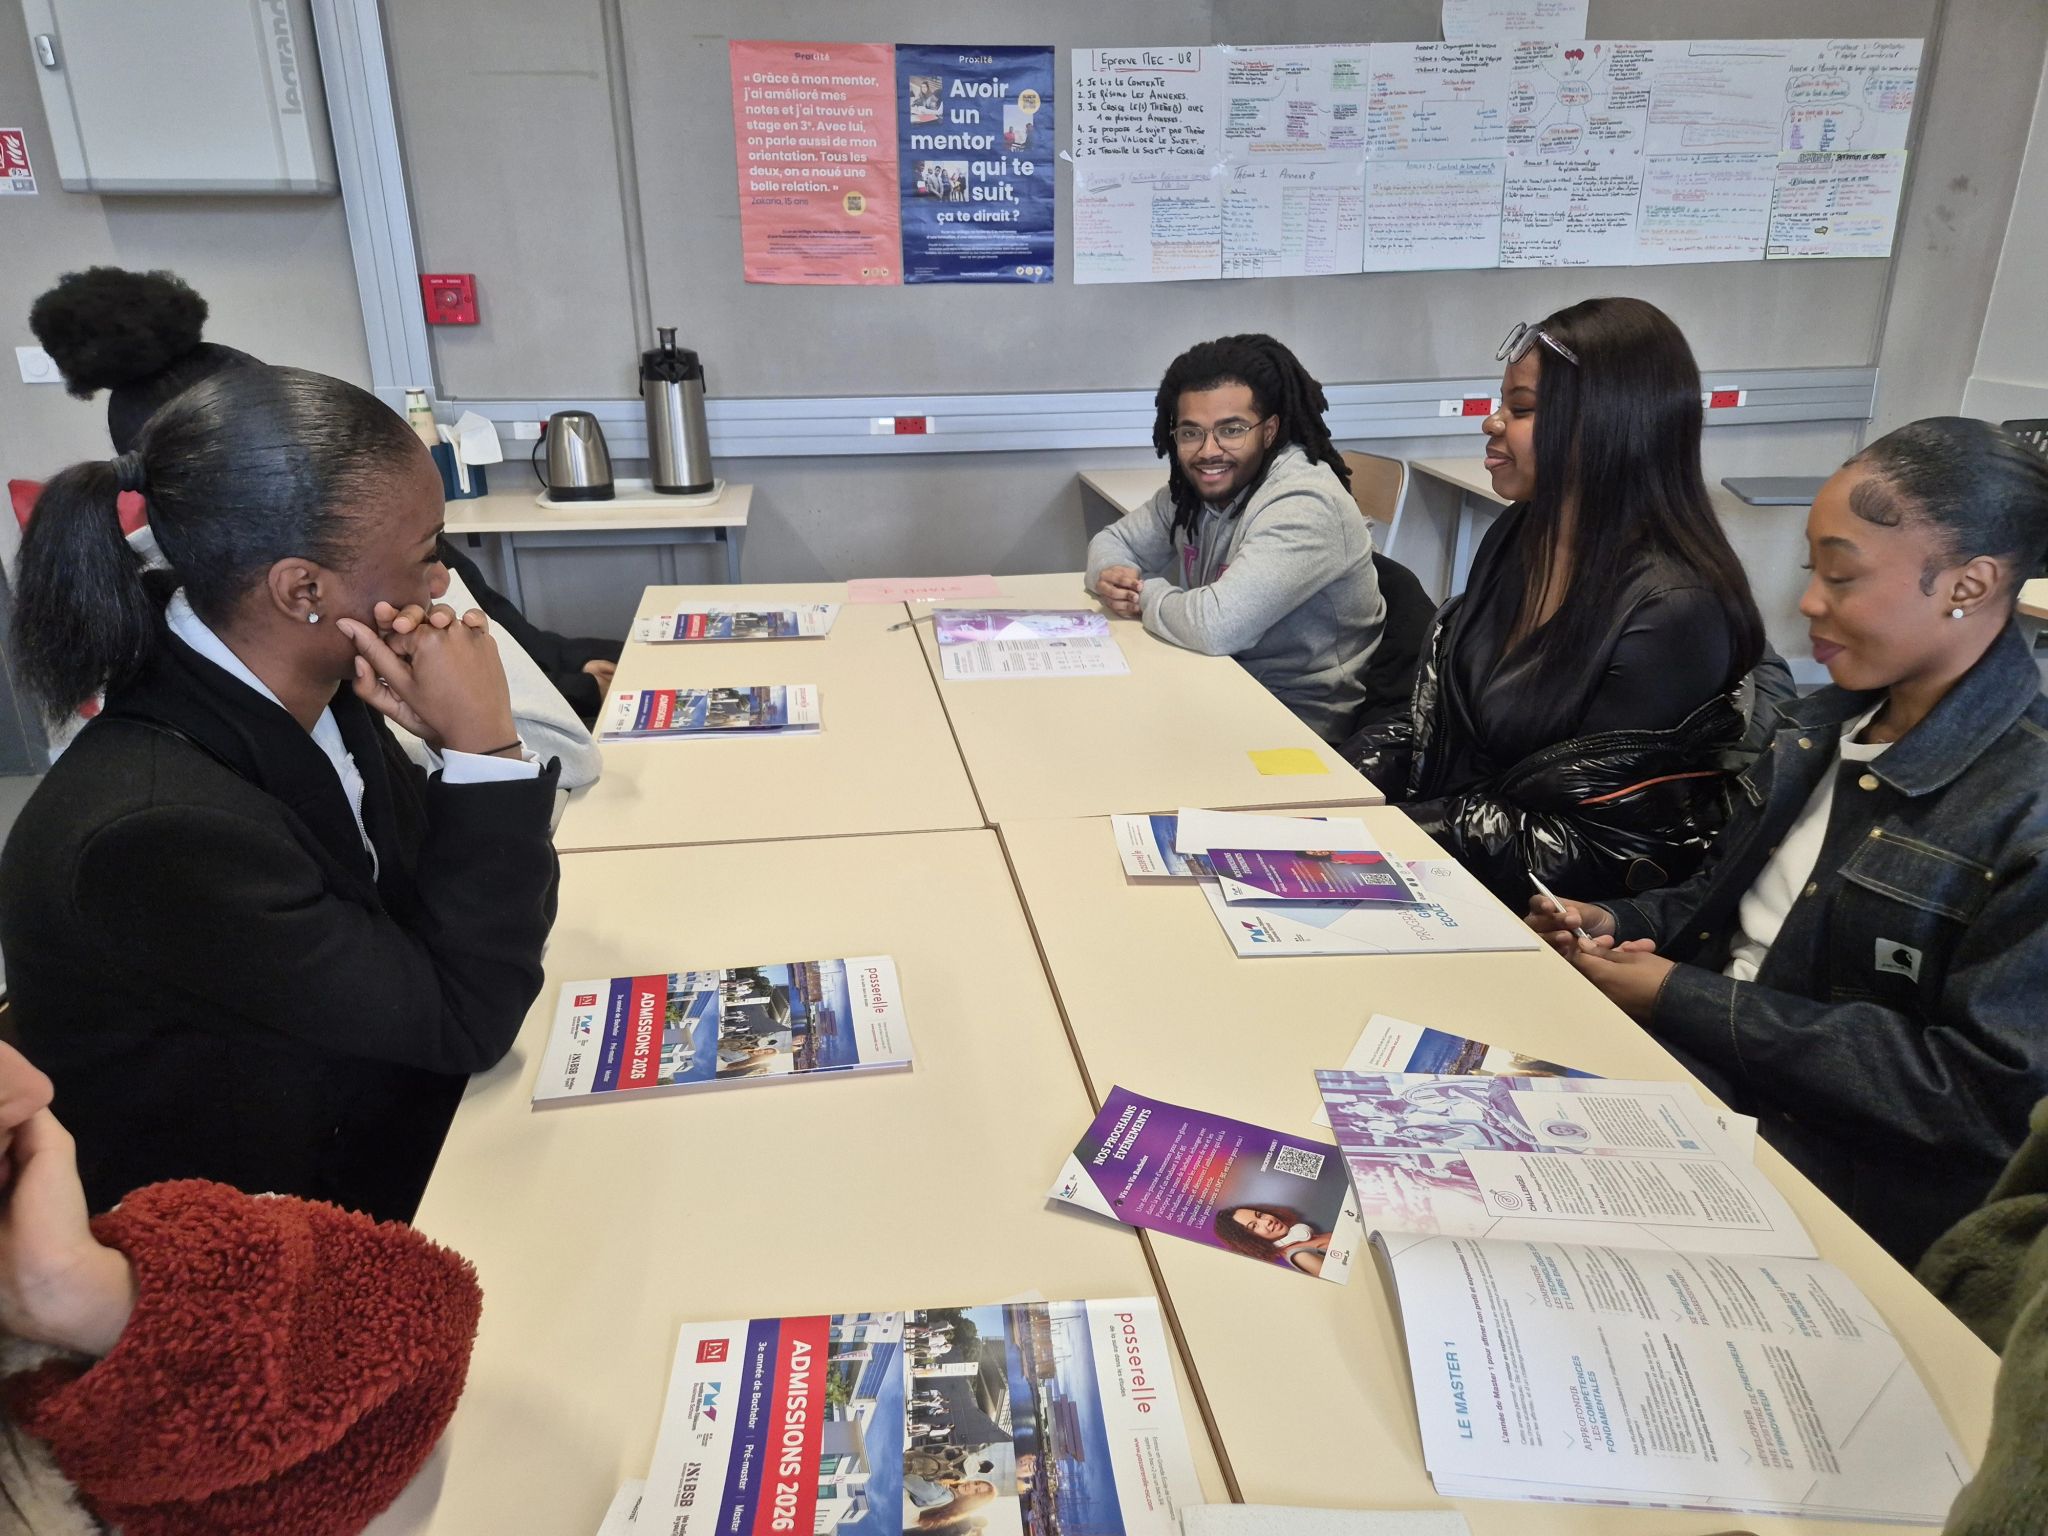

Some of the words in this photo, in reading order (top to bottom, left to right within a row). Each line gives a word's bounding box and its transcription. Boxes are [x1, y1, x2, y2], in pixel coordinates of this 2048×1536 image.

[794, 52, 831, 61] Proxité
[959, 55, 993, 64] Proxité
[752, 72, 789, 84] Grâce
[791, 73, 799, 84] à
[802, 76, 829, 84] mon
[831, 76, 879, 87] mentor,
[950, 77, 1009, 98] Avoir
[744, 87, 763, 101] j'ai
[765, 88, 819, 100] amélioré
[821, 91, 847, 100] mes
[745, 105, 780, 115] notes
[781, 105, 794, 115] et
[796, 104, 814, 118] j'ai
[815, 105, 855, 117] trouvé
[857, 107, 873, 117] un
[950, 108, 980, 124] un
[746, 120, 780, 132] stage
[783, 122, 798, 131] en
[817, 121, 846, 132] Avec
[848, 121, 866, 133] lui,
[748, 136, 763, 146] on
[765, 135, 797, 149] parle
[798, 136, 831, 146] aussi
[832, 136, 847, 147] de
[849, 138, 877, 147] mon
[911, 132, 995, 150] mentor
[1167, 147, 1175, 155] +
[749, 150, 818, 162] orientation.
[819, 151, 847, 162] Tous
[850, 151, 867, 162] les
[749, 165, 782, 178] deux,
[784, 168, 800, 177] on
[801, 168, 810, 177] a
[811, 166, 841, 177] noué
[843, 168, 866, 178] une
[971, 155, 1007, 182] qui
[1012, 158, 1035, 176] te
[750, 181, 779, 191] belle
[781, 181, 831, 192] relation.
[972, 181, 1019, 205] suit,
[784, 197, 792, 205] 15
[794, 197, 809, 206] ans
[937, 212, 954, 226] ça
[957, 210, 970, 222] te
[973, 209, 1010, 222] dirait
[1013, 209, 1020, 222] ?
[1427, 903, 1459, 928] ÉCOLE
[864, 967, 889, 1014] passerelle
[635, 991, 656, 1057] ADMISSIONS
[630, 1057, 649, 1080] 2026
[1093, 1147, 1112, 1166] NOS
[1103, 1104, 1137, 1149] PROCHAINS
[1112, 1108, 1152, 1161] ÉVÉNEMENTS
[1132, 1154, 1149, 1176] Bachelor
[1476, 1311, 1484, 1324] son
[758, 1341, 768, 1352] 3e
[1480, 1324, 1489, 1347] affiner
[754, 1353, 765, 1379] année
[1114, 1312, 1157, 1414] passerelle
[1485, 1347, 1495, 1366] pour
[1726, 1340, 1753, 1392] CHERCHEUR
[752, 1379, 764, 1391] de
[1446, 1352, 1470, 1415] MASTER
[1490, 1371, 1501, 1399] Master
[747, 1392, 762, 1430] Bachelor
[779, 1339, 812, 1477] ADMISSIONS
[1569, 1385, 1593, 1451] APPROFONDIR
[1587, 1370, 1617, 1453] FONDAMENTALES
[1457, 1418, 1473, 1440] LE
[1591, 1425, 1602, 1441] LES
[738, 1444, 755, 1491] Pré-master
[679, 1484, 698, 1507] BSB
[771, 1482, 800, 1531] 2026
[730, 1503, 745, 1533] Master
